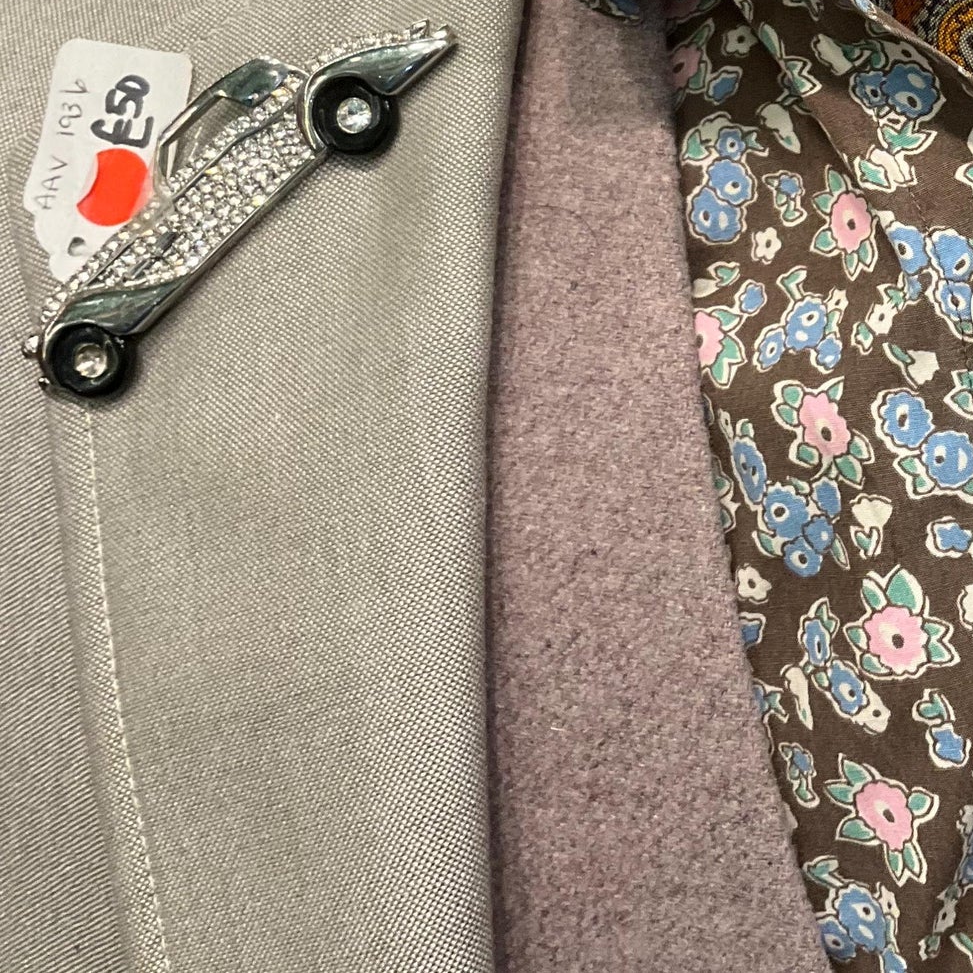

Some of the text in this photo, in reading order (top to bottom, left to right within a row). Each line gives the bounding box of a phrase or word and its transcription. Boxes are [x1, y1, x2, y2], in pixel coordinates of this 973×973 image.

[34, 78, 90, 210] AAV 1936
[90, 74, 154, 149] £50
